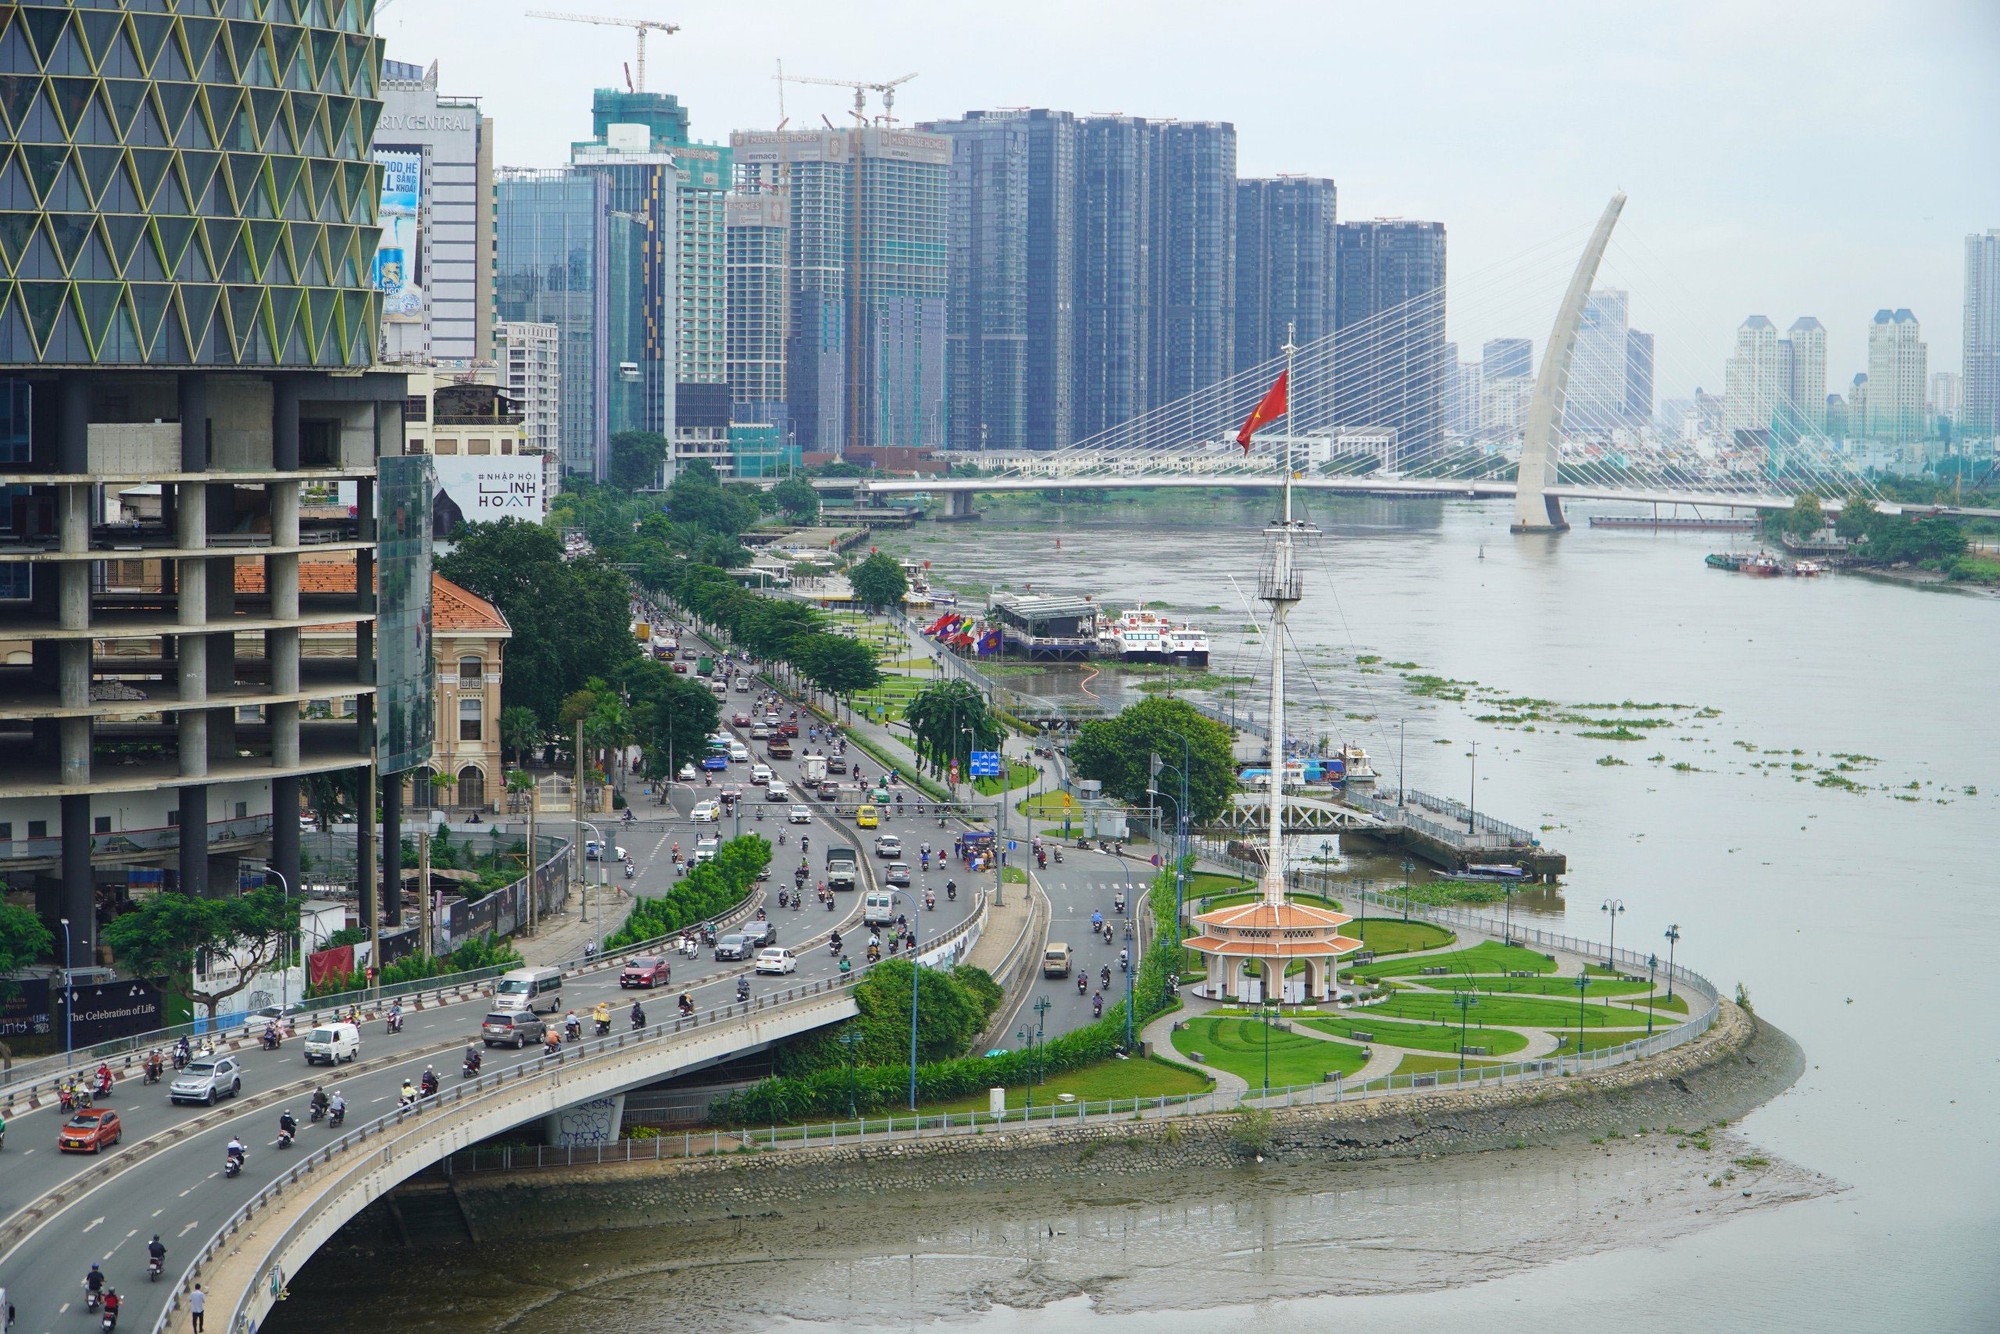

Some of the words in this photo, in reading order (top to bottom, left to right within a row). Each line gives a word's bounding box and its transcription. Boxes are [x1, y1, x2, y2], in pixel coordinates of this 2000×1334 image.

[406, 115, 471, 131] CENTRAL
[518, 471, 536, 482] HỘI
[479, 482, 536, 494] LINH
[479, 495, 536, 507] HOẠT
[68, 1012, 84, 1022] The
[85, 1008, 131, 1021] Celebration
[132, 1004, 141, 1015] of
[140, 1003, 156, 1014] Life
